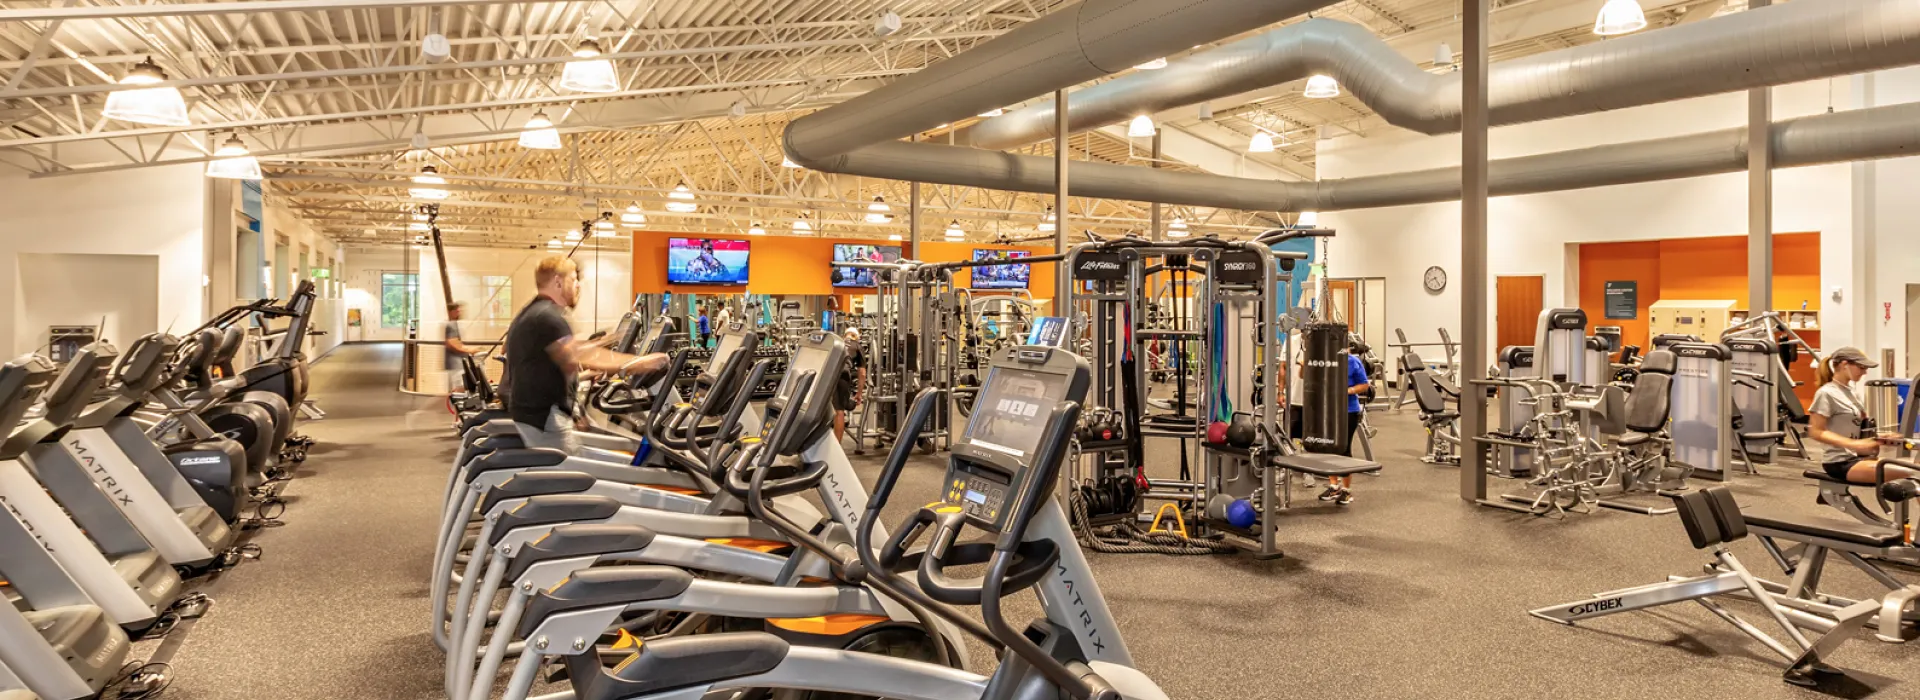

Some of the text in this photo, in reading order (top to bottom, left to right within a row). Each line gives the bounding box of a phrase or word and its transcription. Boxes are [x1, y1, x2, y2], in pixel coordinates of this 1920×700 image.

[69, 439, 134, 507] MATRIX
[827, 473, 858, 531] MATR
[1057, 558, 1105, 655] MATRIX
[1585, 597, 1623, 613] CYBEX
